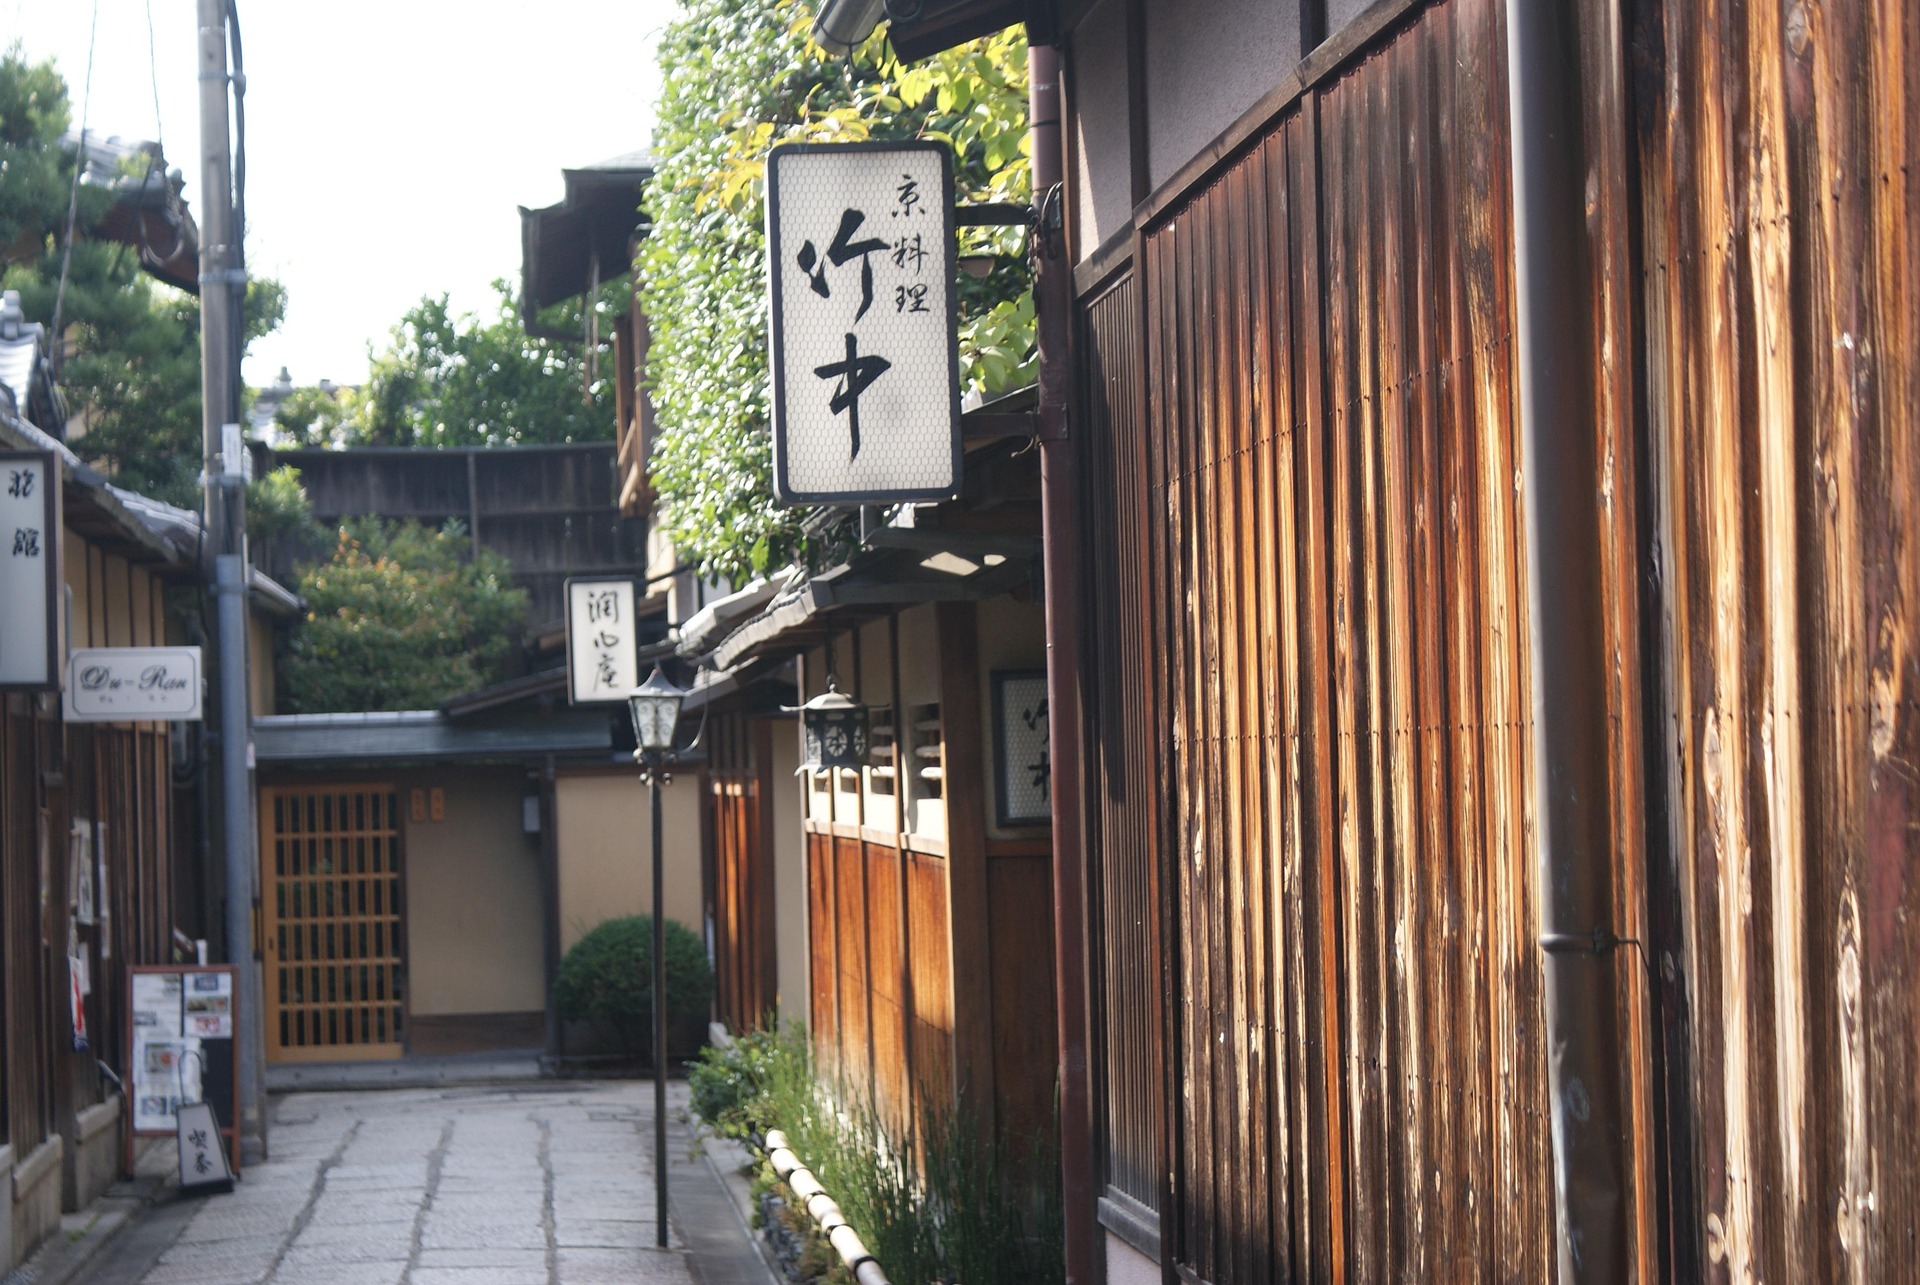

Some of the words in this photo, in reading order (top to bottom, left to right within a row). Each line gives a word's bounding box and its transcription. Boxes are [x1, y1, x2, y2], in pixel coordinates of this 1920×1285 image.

[797, 208, 892, 464] 竹中
[891, 174, 930, 312] 京料理
